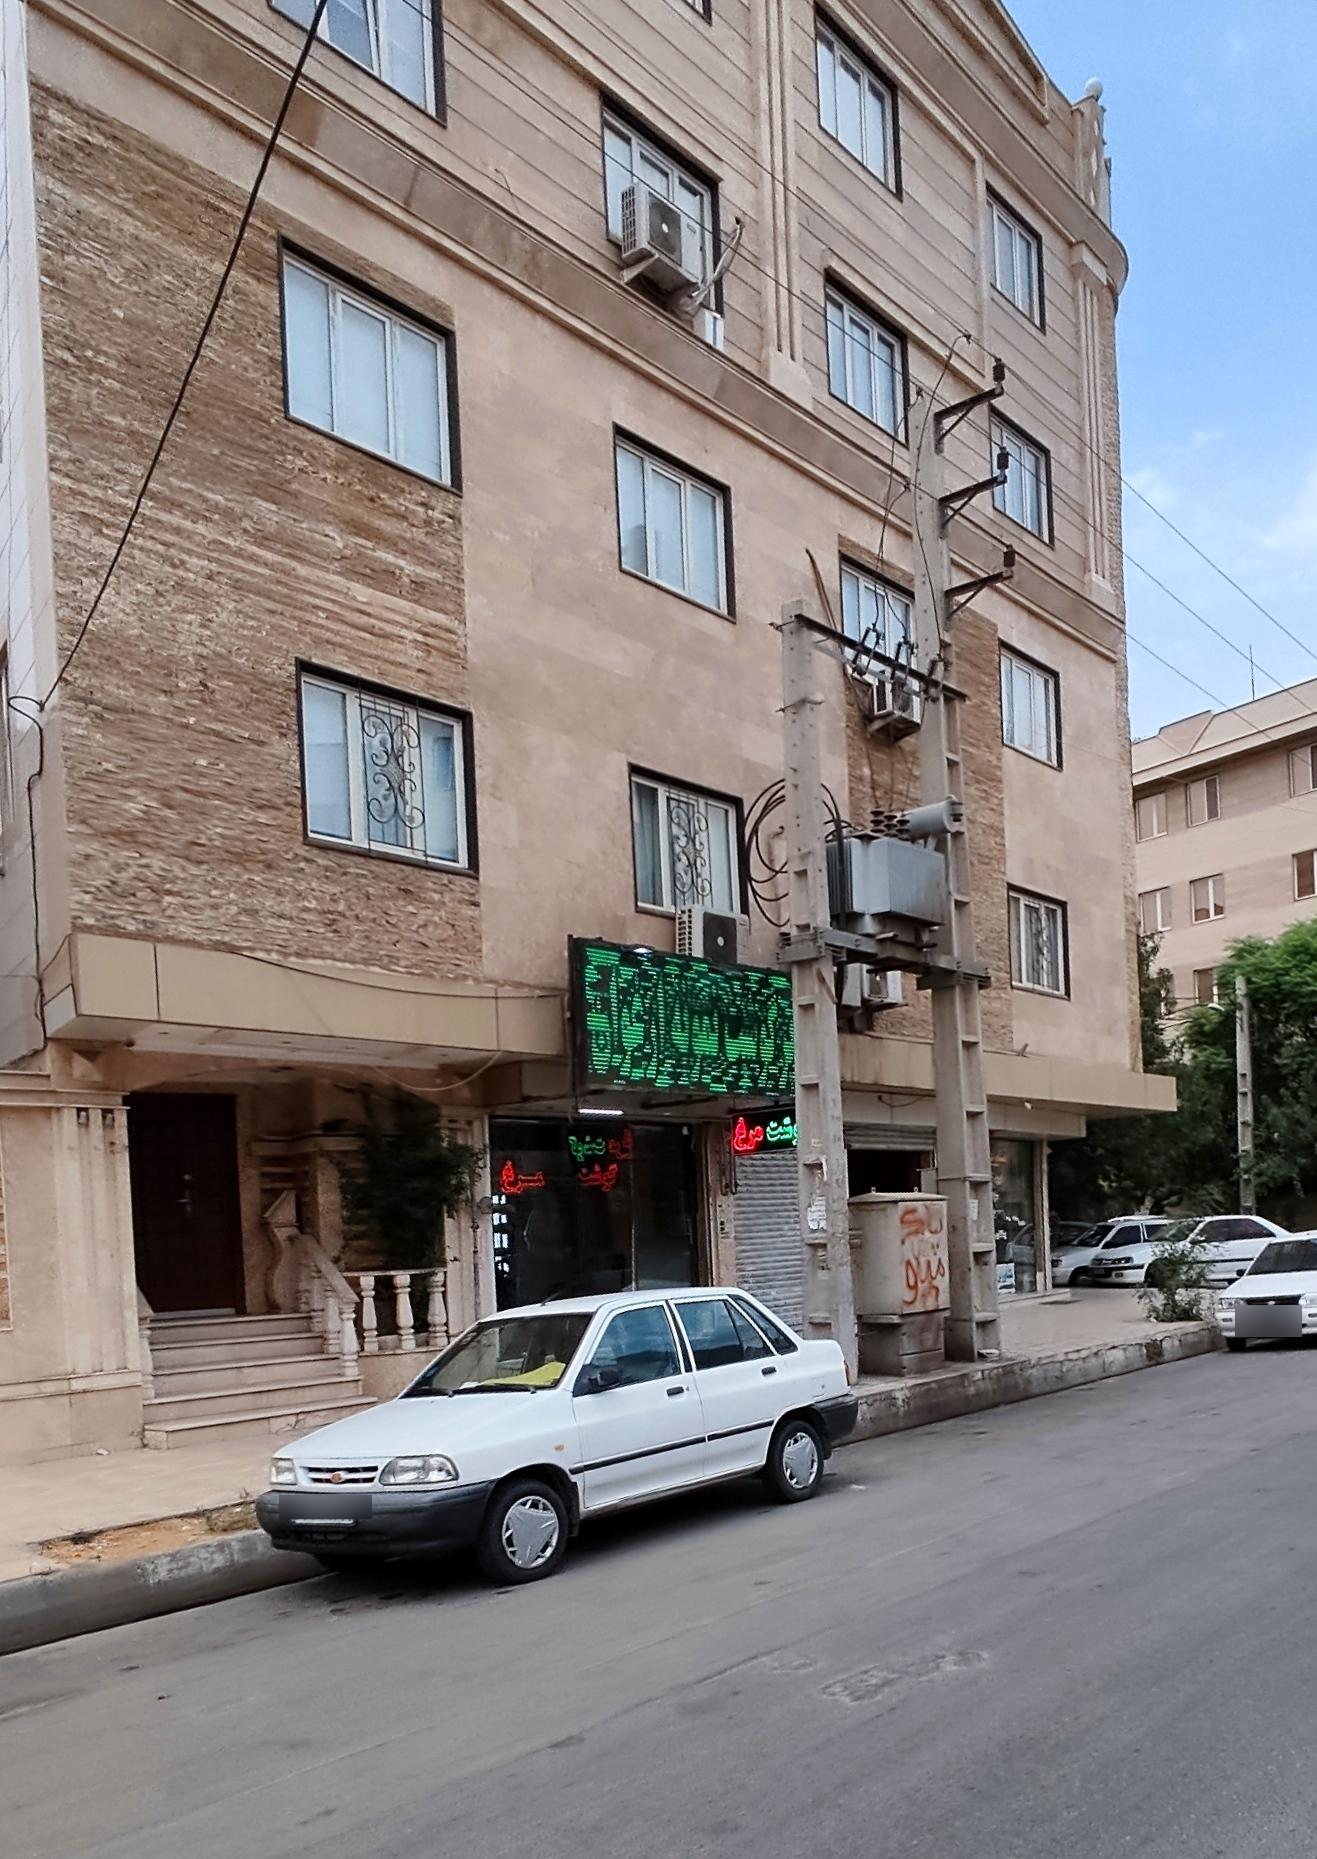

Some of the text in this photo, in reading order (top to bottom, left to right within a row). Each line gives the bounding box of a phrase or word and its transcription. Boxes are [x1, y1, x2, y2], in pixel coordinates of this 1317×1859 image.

[734, 1116, 764, 1151] مرغ
[501, 1159, 619, 1194] گوشت مرغ
